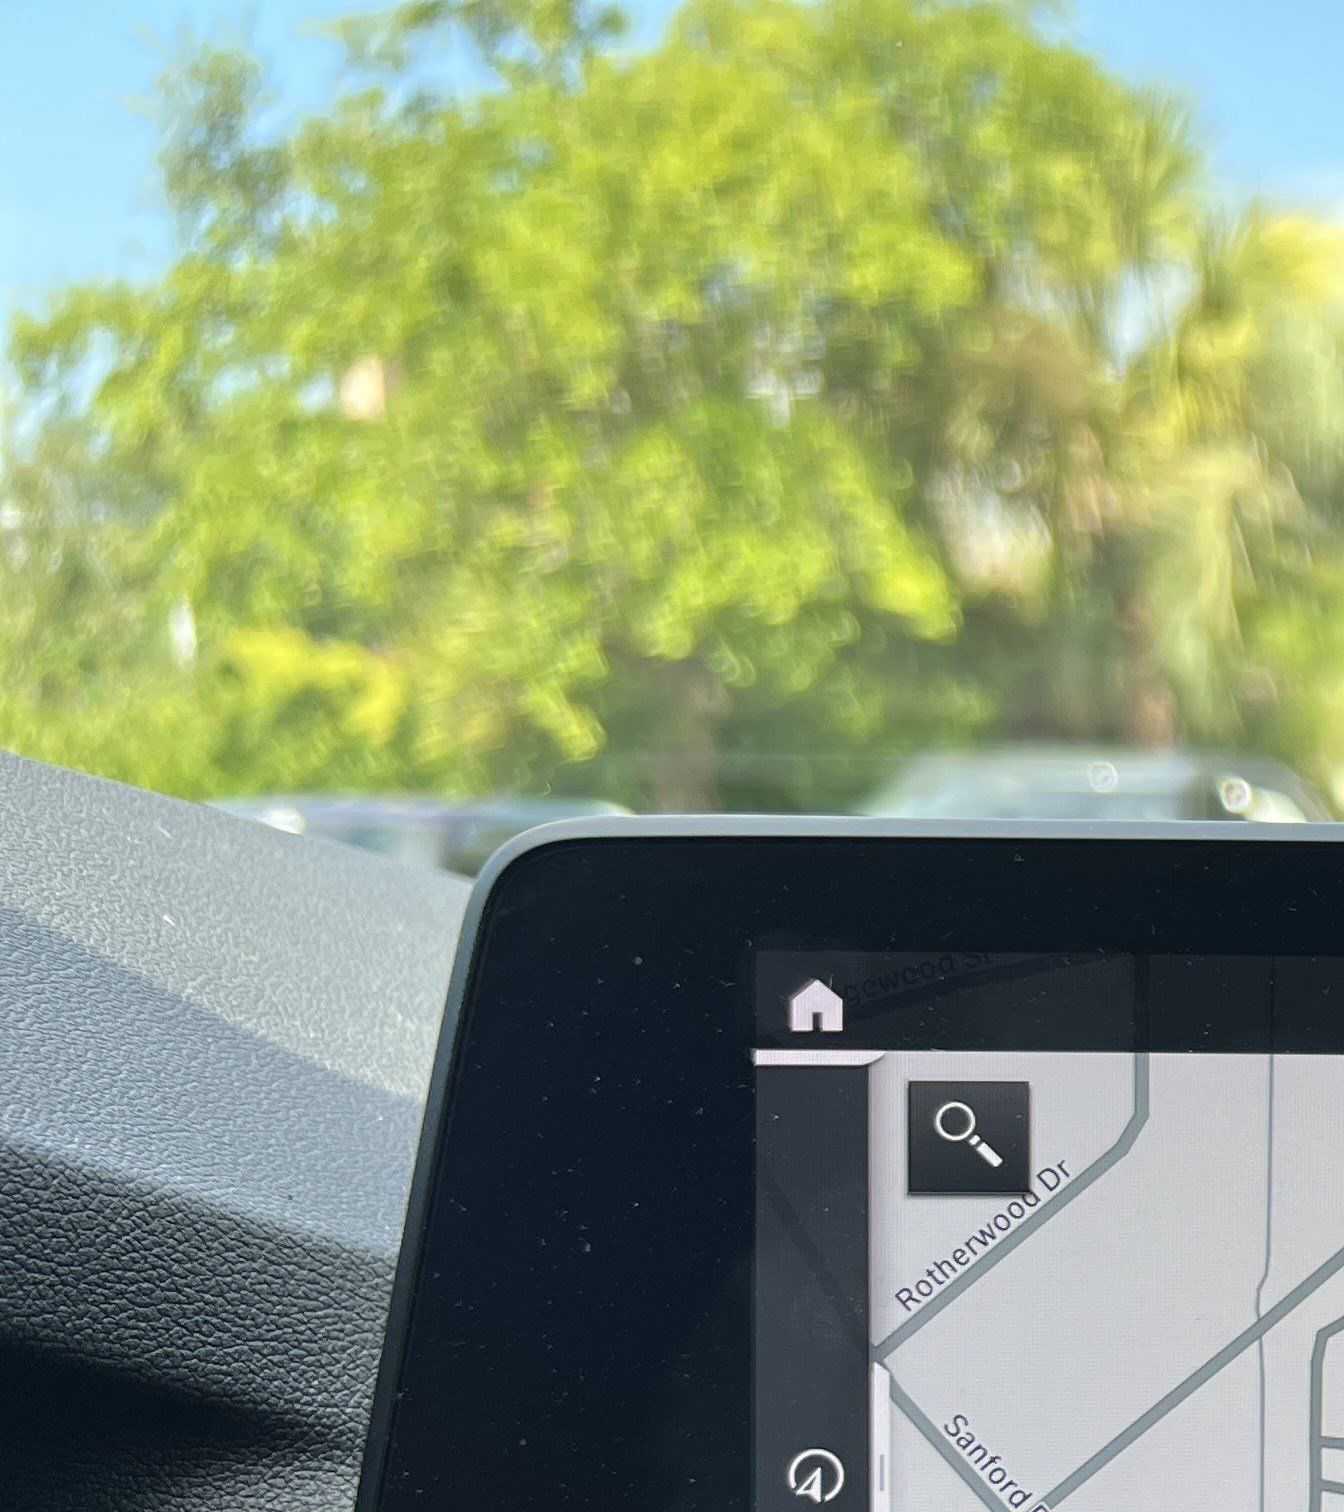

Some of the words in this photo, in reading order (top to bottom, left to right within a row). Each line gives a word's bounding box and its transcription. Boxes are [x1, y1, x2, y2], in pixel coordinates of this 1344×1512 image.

[894, 1190, 1042, 1312] Rotherwood
[1036, 1159, 1071, 1192] Dr
[943, 1413, 1034, 1509] Sanford
